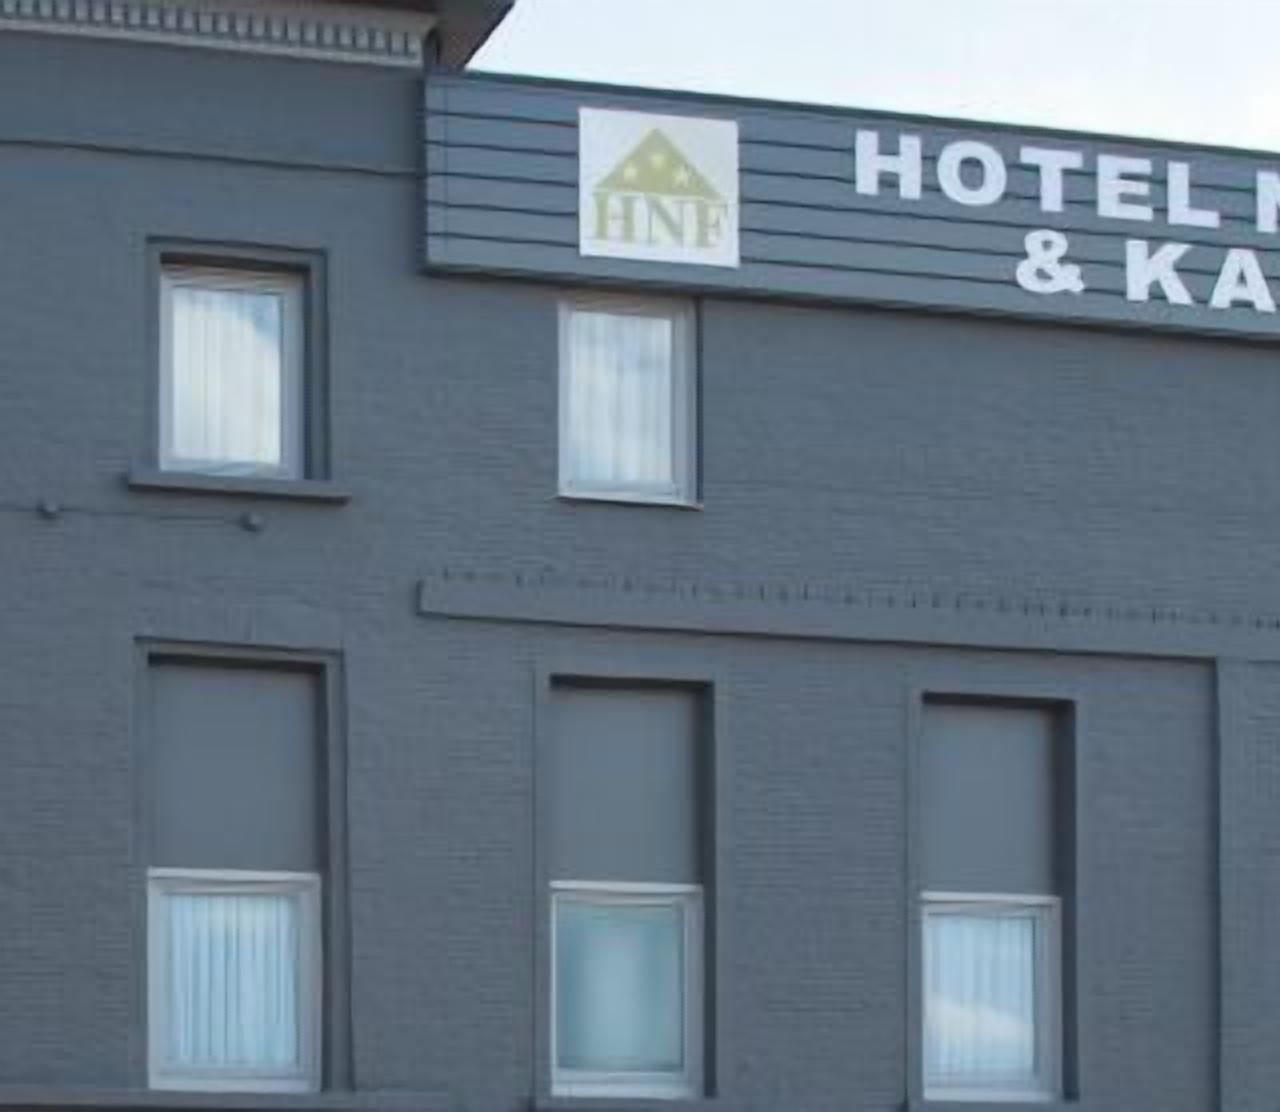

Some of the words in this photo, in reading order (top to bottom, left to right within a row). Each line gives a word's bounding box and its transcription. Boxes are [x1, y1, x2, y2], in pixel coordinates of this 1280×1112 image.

[854, 129, 1221, 229] HOTEL
[592, 188, 729, 249] HNF
[1014, 228, 1086, 294] &
